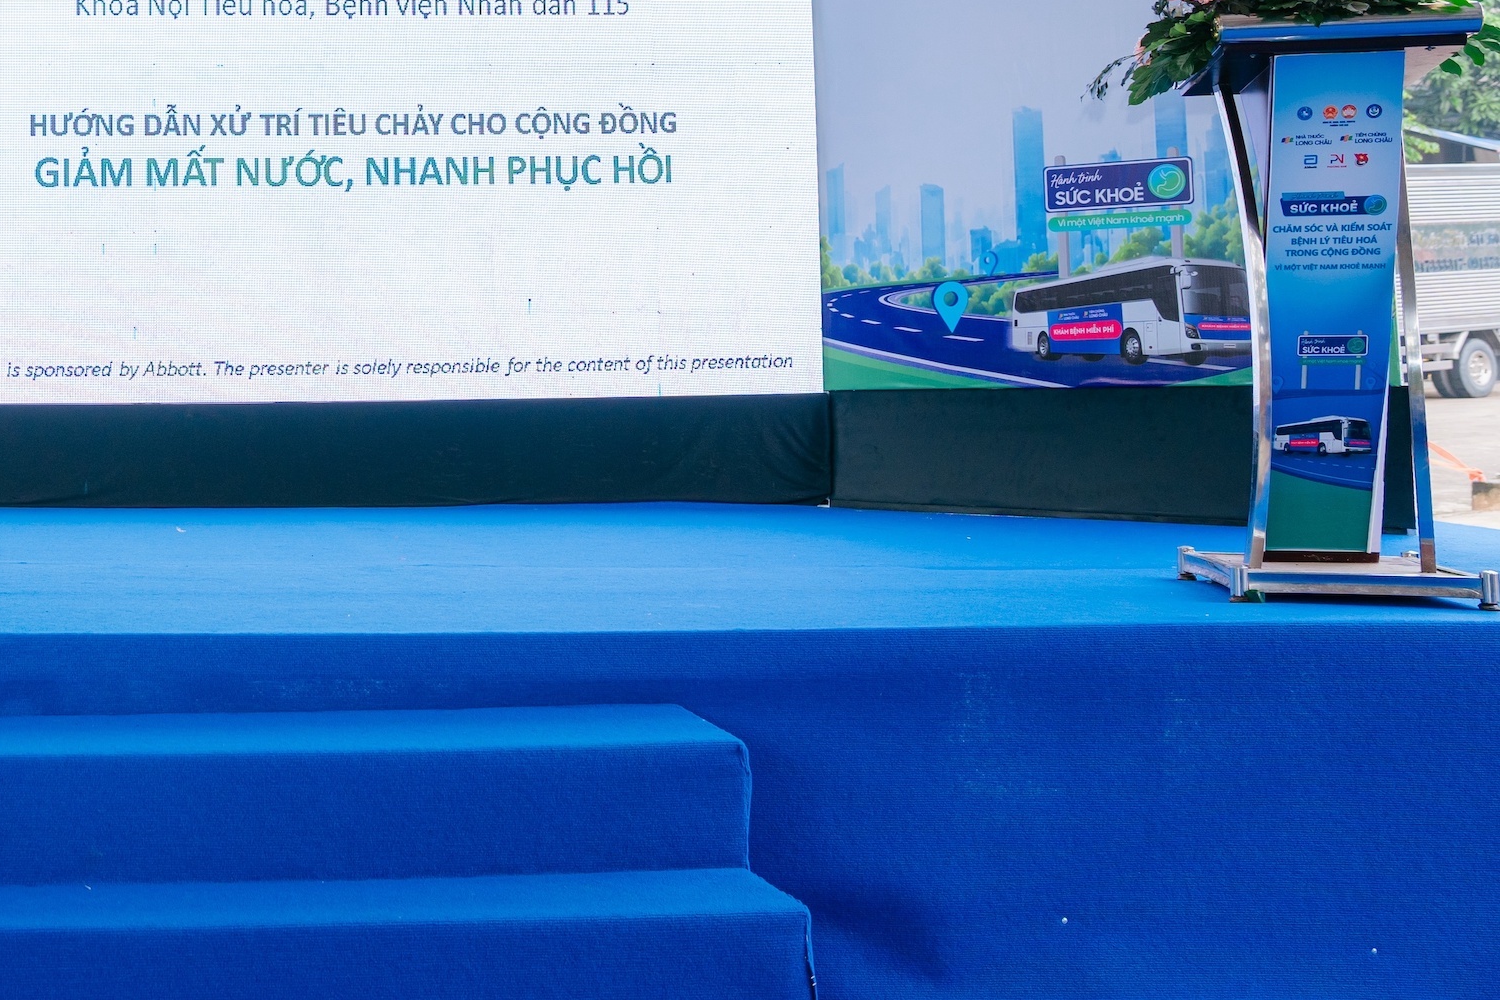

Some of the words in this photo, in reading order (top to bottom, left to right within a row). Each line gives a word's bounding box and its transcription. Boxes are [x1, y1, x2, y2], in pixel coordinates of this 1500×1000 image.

[29, 107, 135, 137] HƯỚNG
[143, 104, 201, 137] DẪN
[209, 111, 252, 137] XỬ
[259, 107, 300, 137] TRÍ
[307, 107, 367, 137] TIÊU
[375, 104, 444, 136] CHẢY
[450, 112, 504, 136] CHO
[515, 106, 591, 140] CỘNG
[597, 103, 678, 135] ĐỒNG
[34, 147, 133, 188] GIẢM
[147, 146, 225, 187] MẤT
[236, 149, 354, 193] NƯỚC,
[365, 156, 495, 186] NHANH
[507, 155, 601, 191] PHỤC
[613, 143, 672, 185] HỒI
[1055, 187, 1092, 206] SỨC
[1095, 182, 1144, 204] KHOẺ
[1290, 201, 1318, 214] SỨC
[1320, 200, 1359, 213] KHOẺ
[1057, 218, 1067, 227] Vì
[1067, 218, 1087, 228] một
[1088, 217, 1105, 227] Việt
[1106, 216, 1129, 225] Nam
[1155, 213, 1185, 224] mạnh
[1272, 223, 1302, 233] CHĂM
[1304, 223, 1324, 232] SÓC
[1326, 222, 1339, 232] VÀ
[1367, 222, 1393, 231] SOÁT
[1291, 236, 1317, 247] BỆNH
[1319, 235, 1331, 245] LÝ
[1332, 235, 1353, 244] TIÊU
[1355, 234, 1378, 244] HOÁ
[1285, 249, 1319, 257] TRONG
[1321, 247, 1349, 258] CỘNG
[1351, 246, 1381, 256] ĐỒNG
[7, 362, 21, 377] is
[24, 362, 113, 380] sponsored
[119, 361, 139, 380] by
[143, 362, 206, 377] Abbott.
[213, 361, 245, 376] The
[248, 362, 329, 380] presenter
[335, 360, 349, 376] is
[353, 359, 401, 378] solely
[406, 358, 500, 378] responsible
[505, 357, 531, 376] for
[535, 357, 563, 372] the
[568, 357, 631, 372] content
[635, 355, 655, 374] of
[657, 354, 687, 371] this
[691, 353, 794, 373] presentation
